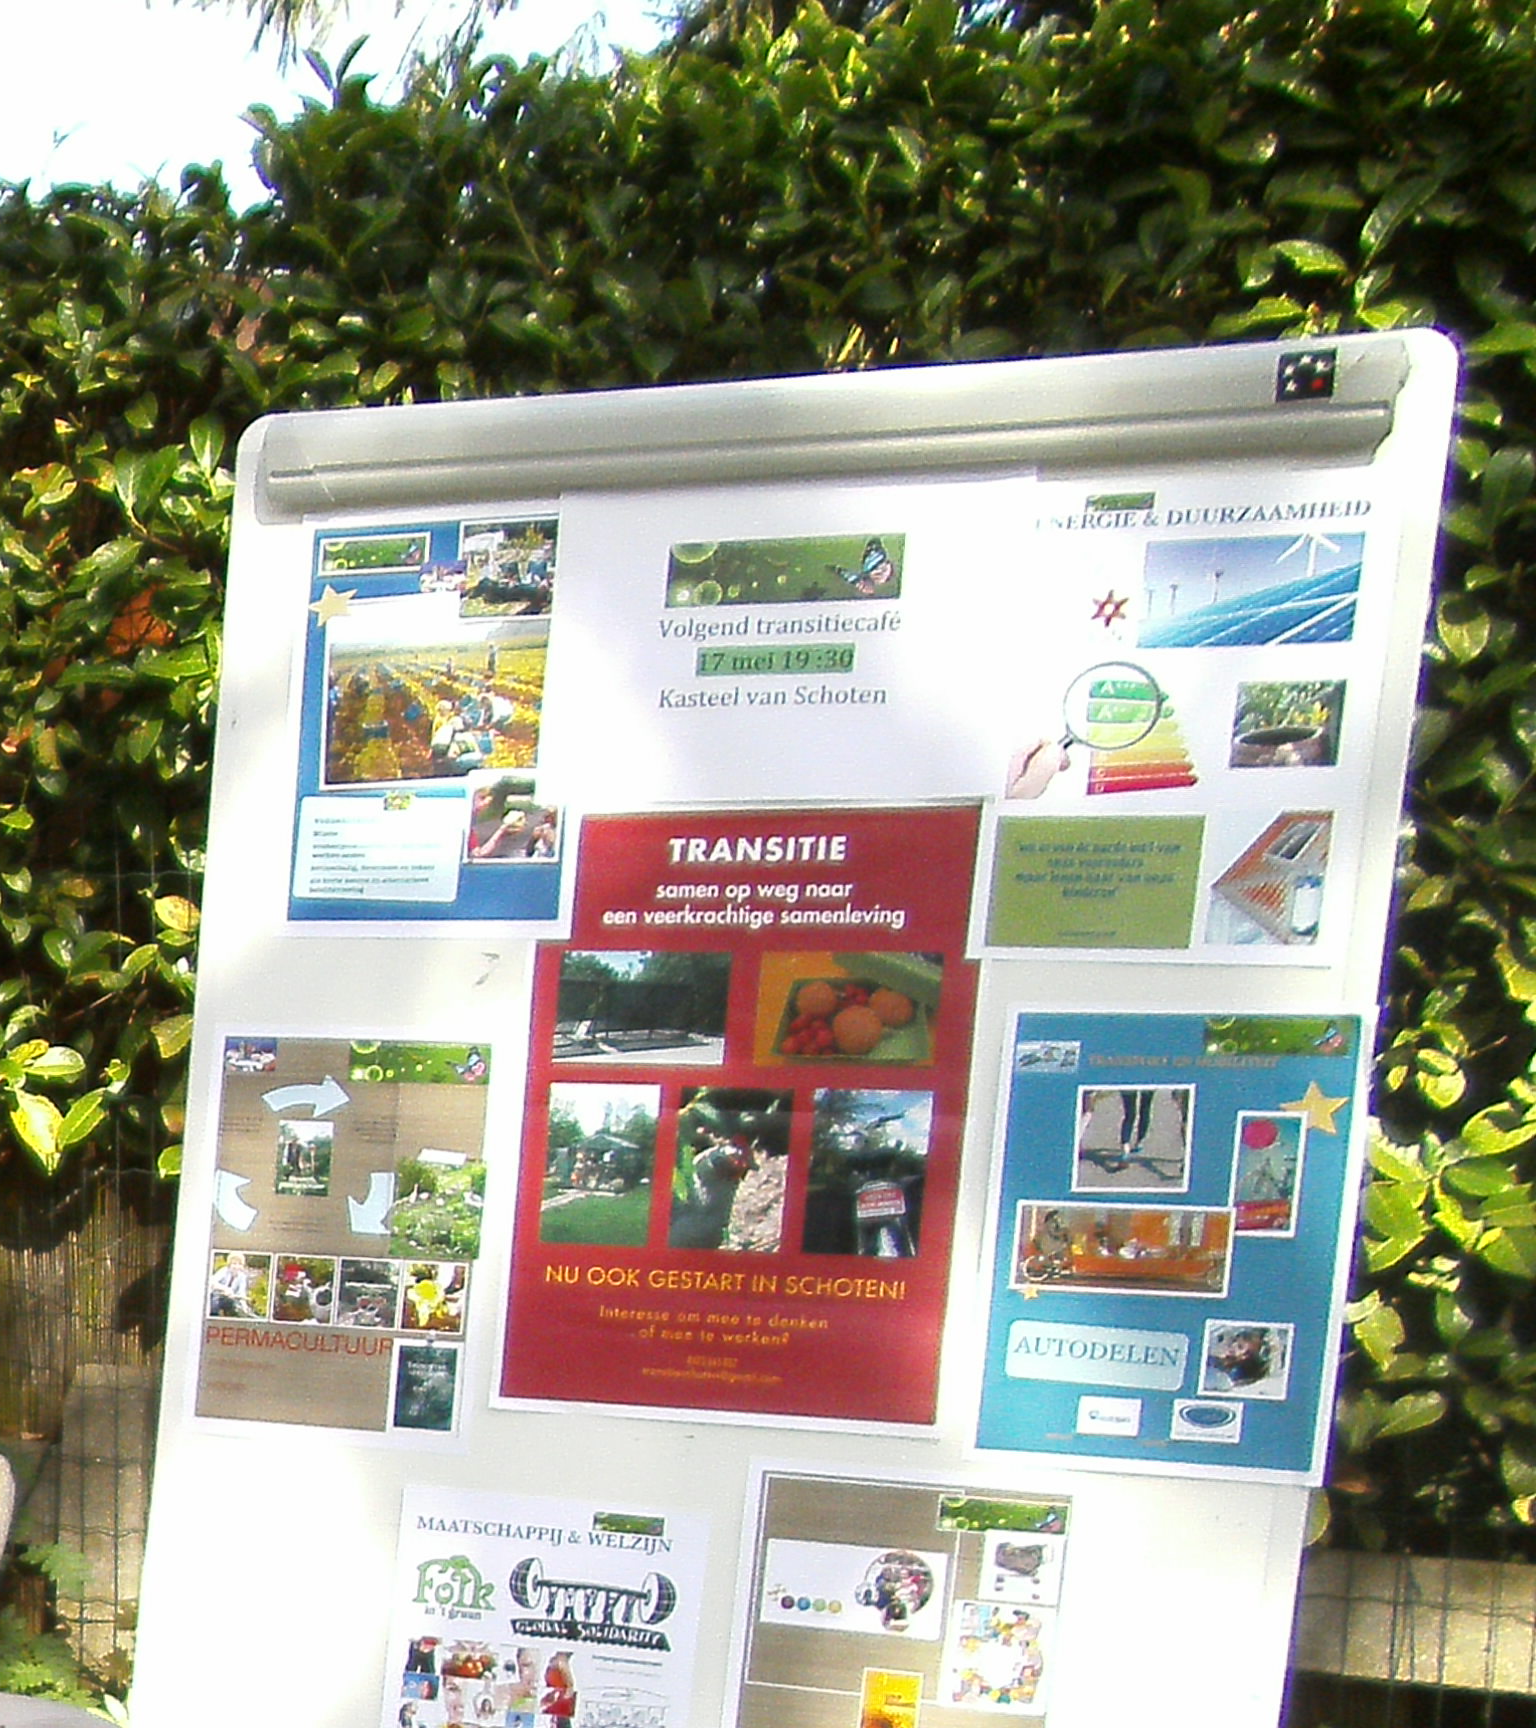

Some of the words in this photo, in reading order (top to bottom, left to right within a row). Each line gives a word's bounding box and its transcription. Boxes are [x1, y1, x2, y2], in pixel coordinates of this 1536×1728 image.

[1035, 510, 1136, 532] NERGIE
[1143, 511, 1159, 527] &
[1167, 499, 1372, 526] DUURZAAMHEID
[659, 616, 749, 642] Volgend
[757, 610, 902, 635] transitiecafé
[700, 652, 725, 672] 17
[732, 652, 773, 671] mei
[783, 650, 810, 670] 19
[659, 686, 739, 709] Kasteel
[746, 690, 786, 705] van
[794, 685, 887, 706] Schoten
[668, 835, 848, 864] TRANSITIE
[656, 883, 719, 899] samen
[725, 885, 751, 903] op
[757, 884, 799, 902] weg
[805, 882, 853, 898] naar
[602, 910, 637, 925] een
[644, 904, 774, 929] veerkrachtige
[780, 904, 906, 929] samenleving
[545, 1264, 580, 1285] NU
[586, 1266, 641, 1288] OOK
[648, 1269, 746, 1292] GESTART
[751, 1274, 778, 1294] IN
[784, 1275, 907, 1300] SCHOTEN!
[599, 1305, 670, 1322] Interesse
[677, 1311, 700, 1323] om
[706, 1313, 740, 1326] mee
[768, 1313, 829, 1330] denken
[206, 1326, 395, 1357] PERMACULTUUR
[638, 1324, 656, 1338] of
[722, 1331, 790, 1345] werken?
[1014, 1335, 1180, 1367] AUTODELEN
[416, 1515, 563, 1547] MAATSCHAPPIJ
[568, 1530, 582, 1545] &
[588, 1530, 674, 1557] WELZIJN
[412, 1555, 496, 1611] Folk
[514, 1620, 569, 1635] GLOBAL
[577, 1622, 662, 1647] SOLIDARITY
